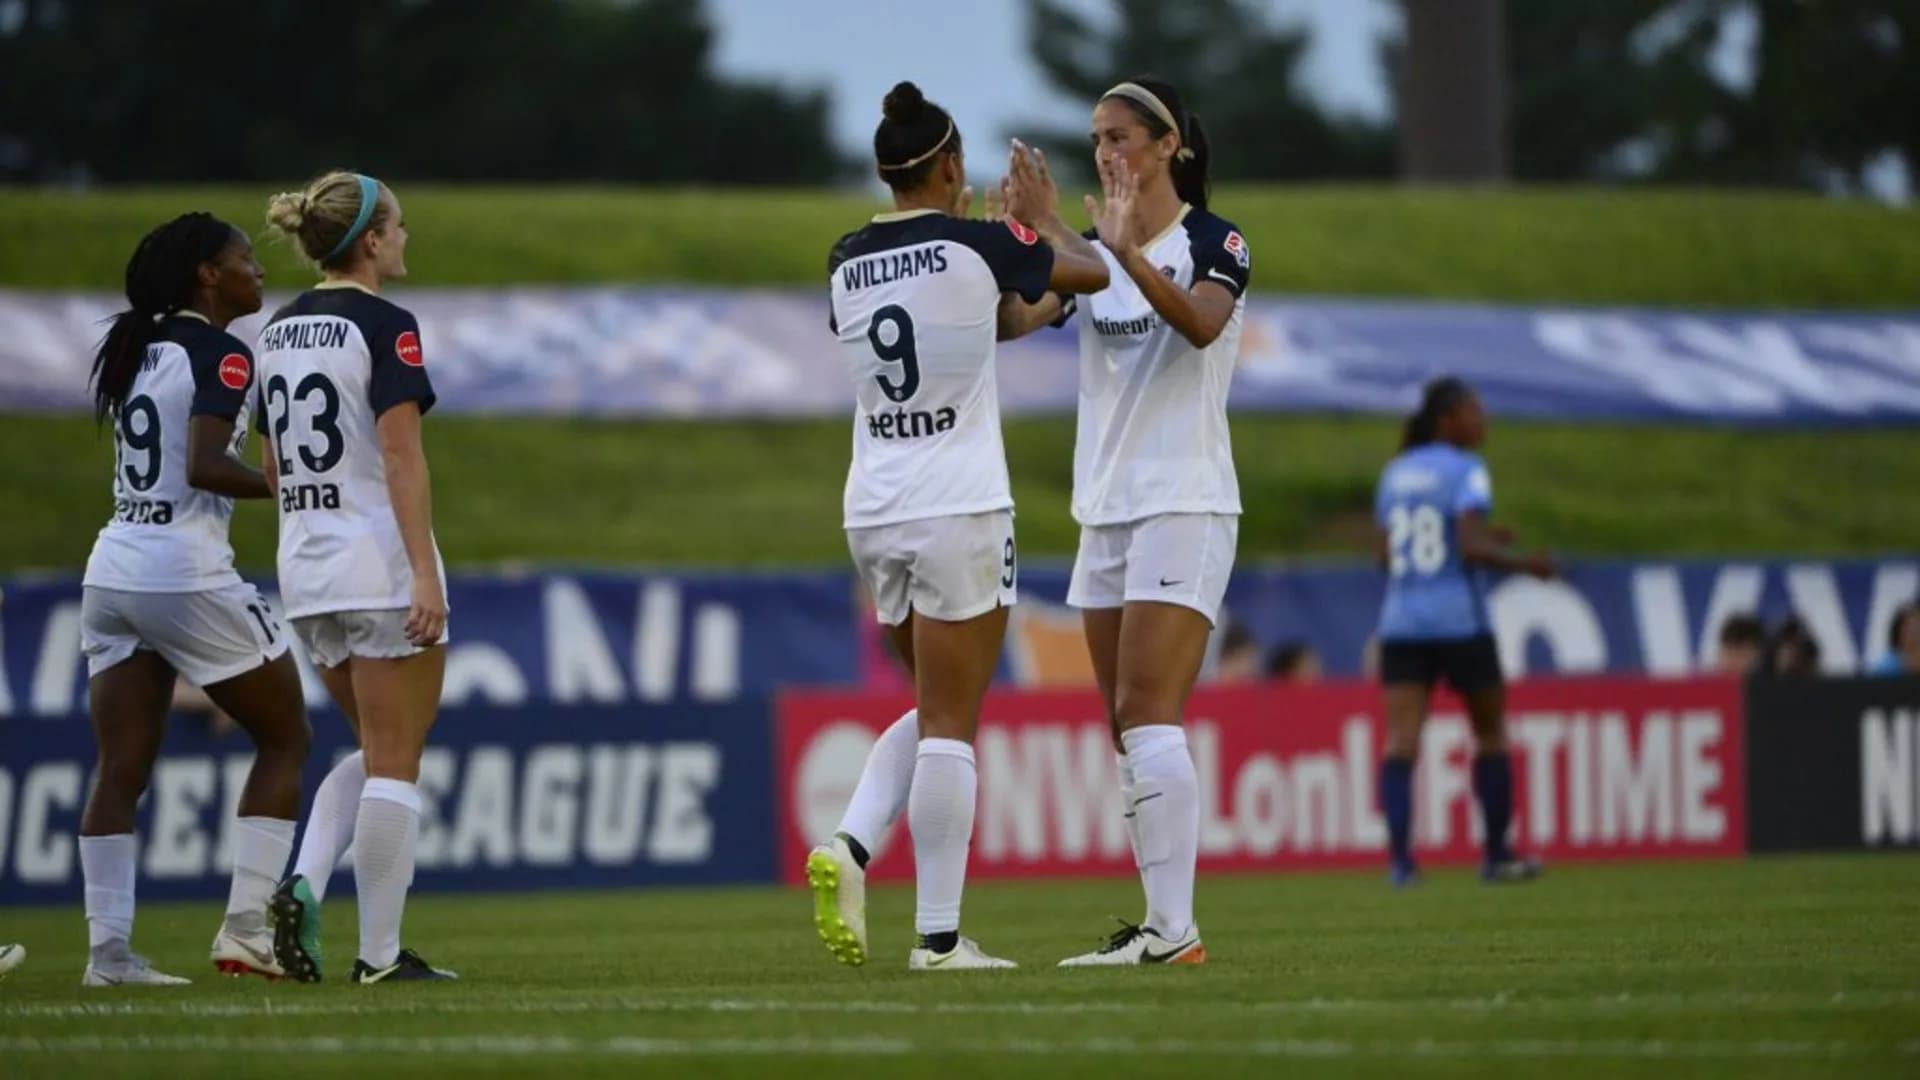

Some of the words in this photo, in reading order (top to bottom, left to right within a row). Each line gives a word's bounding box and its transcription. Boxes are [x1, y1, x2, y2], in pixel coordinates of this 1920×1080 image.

[843, 245, 948, 292] WILLIAMS
[264, 321, 349, 351] HAMILTON
[868, 303, 920, 403] 9
[267, 372, 345, 473] 23
[866, 406, 957, 439] aetna
[1002, 537, 1015, 589] 9
[1389, 504, 1447, 577] 28
[332, 742, 719, 868] EAGUE
